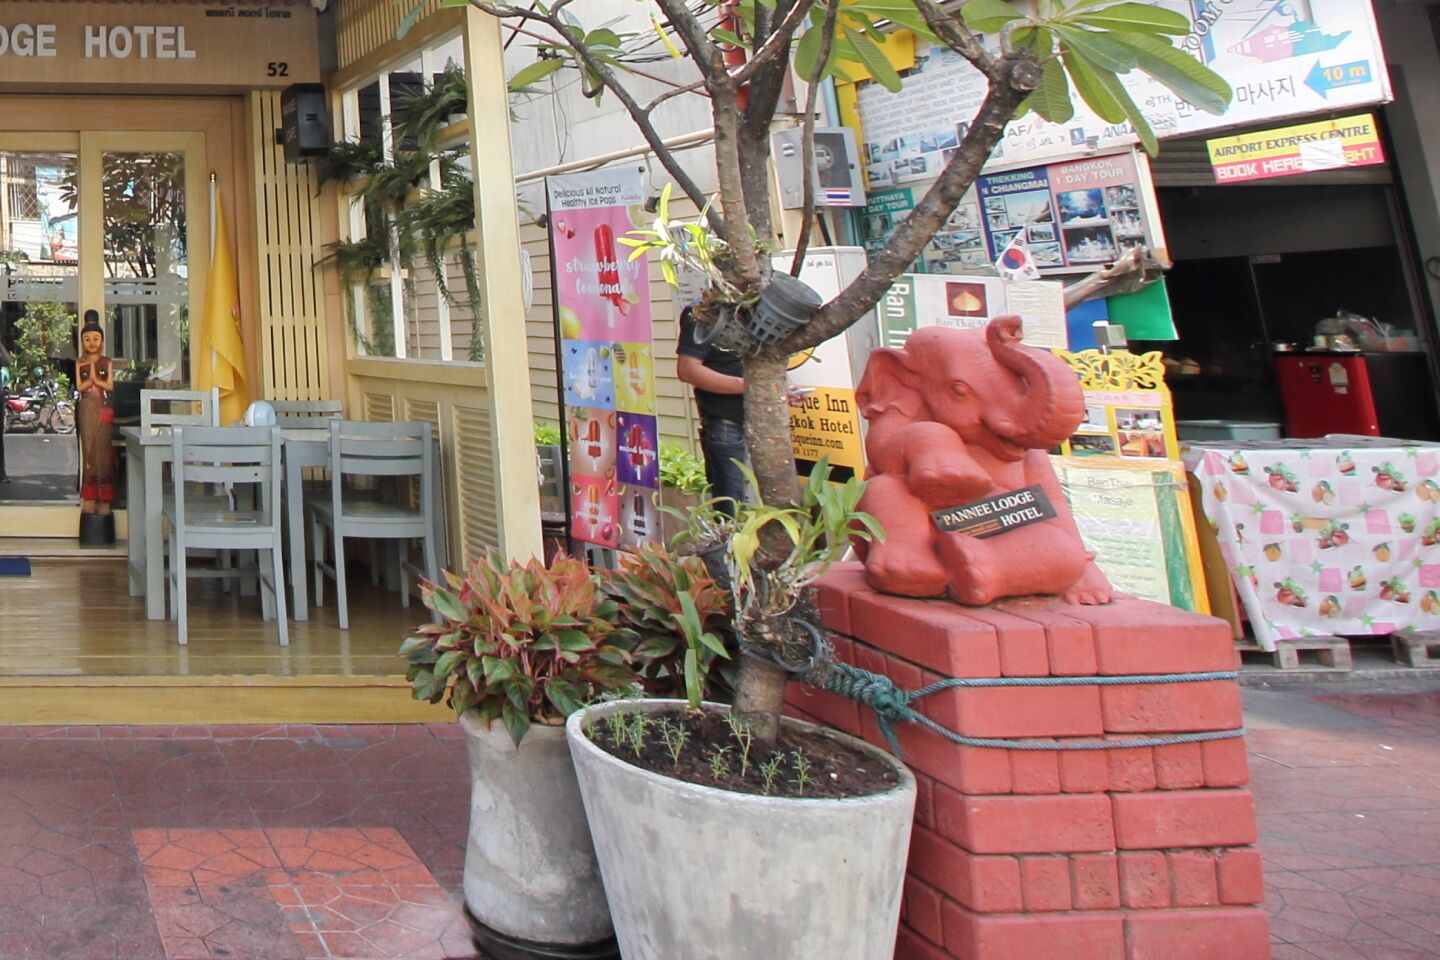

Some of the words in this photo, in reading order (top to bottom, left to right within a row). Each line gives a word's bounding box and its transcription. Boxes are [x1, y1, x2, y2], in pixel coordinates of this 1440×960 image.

[84, 25, 197, 59] HOTEL
[266, 62, 289, 77] 52
[1322, 67, 1344, 81] 10
[1235, 75, 1297, 105] 마사지
[1214, 140, 1263, 158] AIRPORT
[1266, 132, 1318, 150] EXPRESS
[1319, 124, 1371, 141] CENTRE
[1060, 159, 1114, 174] BANGKOK
[1065, 173, 1088, 184] DAY
[1092, 167, 1124, 180] TOUR
[1215, 162, 1259, 180] BOOK
[1262, 156, 1305, 174] HERE
[986, 171, 1035, 184] TREKKING
[990, 178, 1048, 194] CHIANGMAI
[553, 188, 584, 199] Delicious
[585, 186, 594, 196] All
[595, 183, 622, 194] Natural
[561, 198, 587, 208] Healthy
[588, 197, 598, 206] Ice
[599, 196, 617, 206] Pops
[565, 256, 639, 280] strawberry
[886, 282, 910, 318] Ban
[935, 317, 953, 328] Ban
[824, 393, 850, 413] Inn
[819, 417, 854, 435] Hotel
[941, 502, 993, 526] PANNEE
[990, 490, 1036, 512] LODGE
[999, 506, 1044, 527] HOTEL
